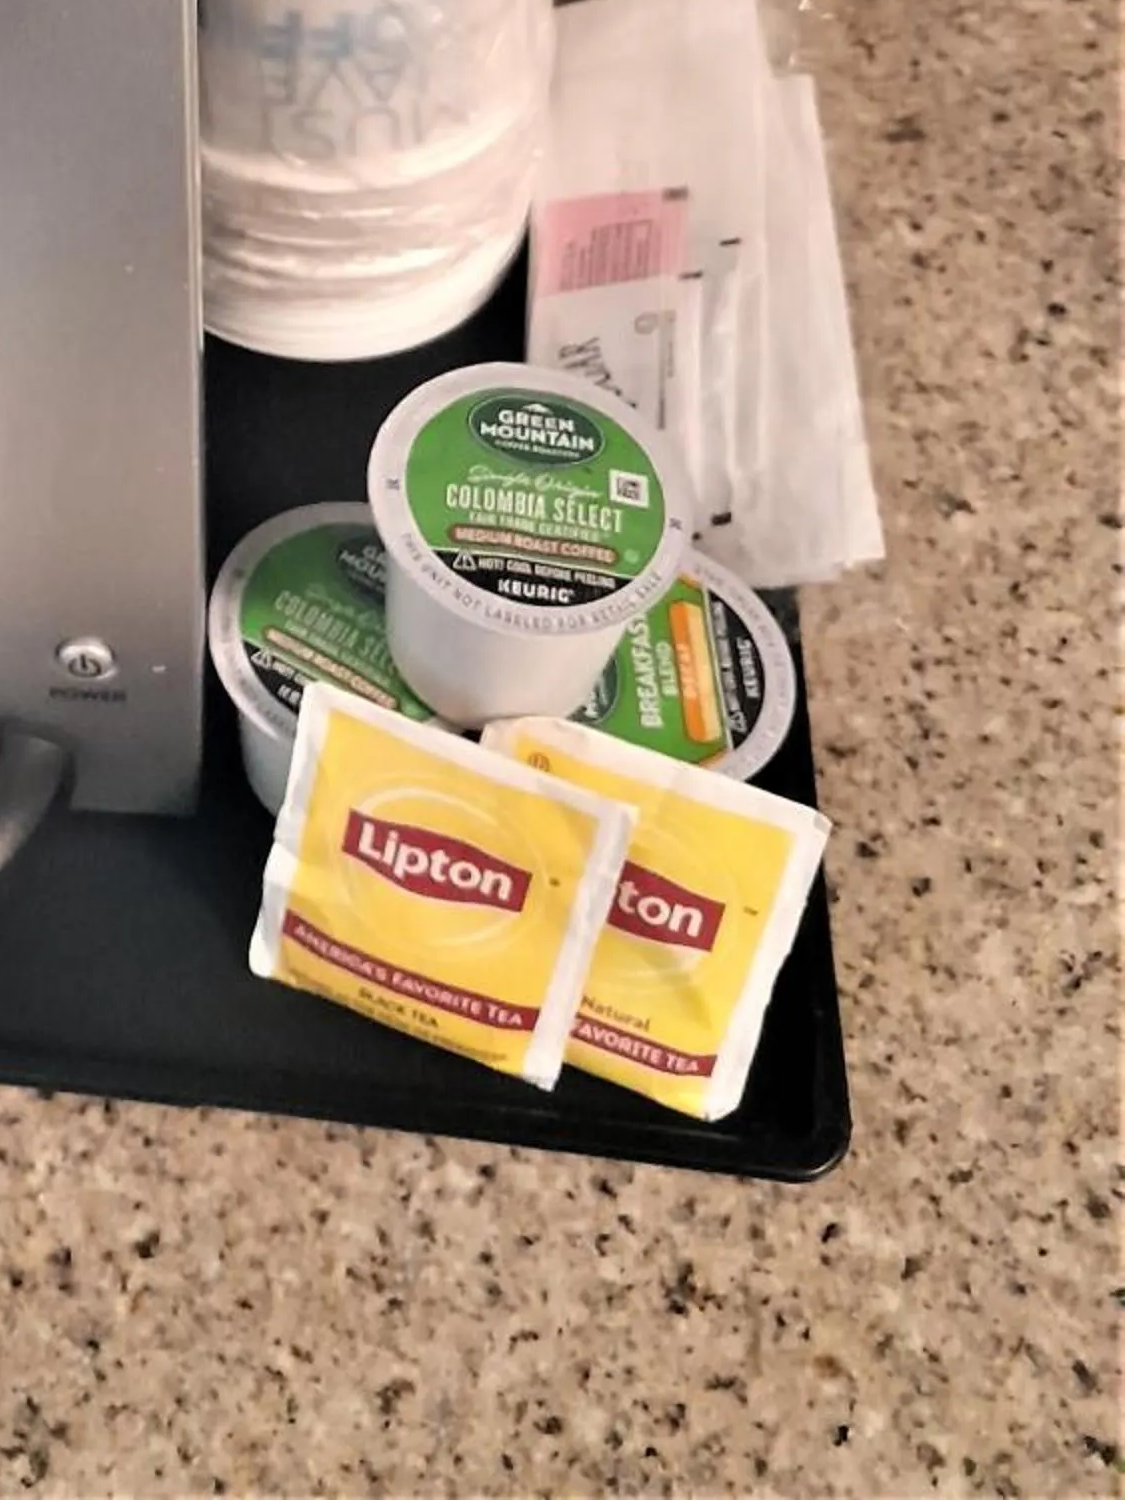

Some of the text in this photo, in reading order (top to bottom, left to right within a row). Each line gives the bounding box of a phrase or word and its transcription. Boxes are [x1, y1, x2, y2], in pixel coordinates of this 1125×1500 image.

[479, 422, 595, 451] MOUNTAIN
[497, 409, 575, 433] GREEN
[445, 482, 625, 534] COLOMBIA SELECT
[454, 526, 617, 564] MEDIUM ROAST COFFEE
[497, 578, 574, 605] KEURIG
[275, 589, 360, 649] COLOMBIA
[357, 820, 514, 902] Lipton
[617, 879, 704, 938] ton
[293, 922, 388, 982] AMERICA'S
[391, 970, 483, 1017] FAVORITE
[487, 1003, 524, 1027] TEA
[358, 986, 440, 1029] BLACK TEA
[580, 994, 651, 1032] Natural
[666, 1052, 700, 1074] TEA
